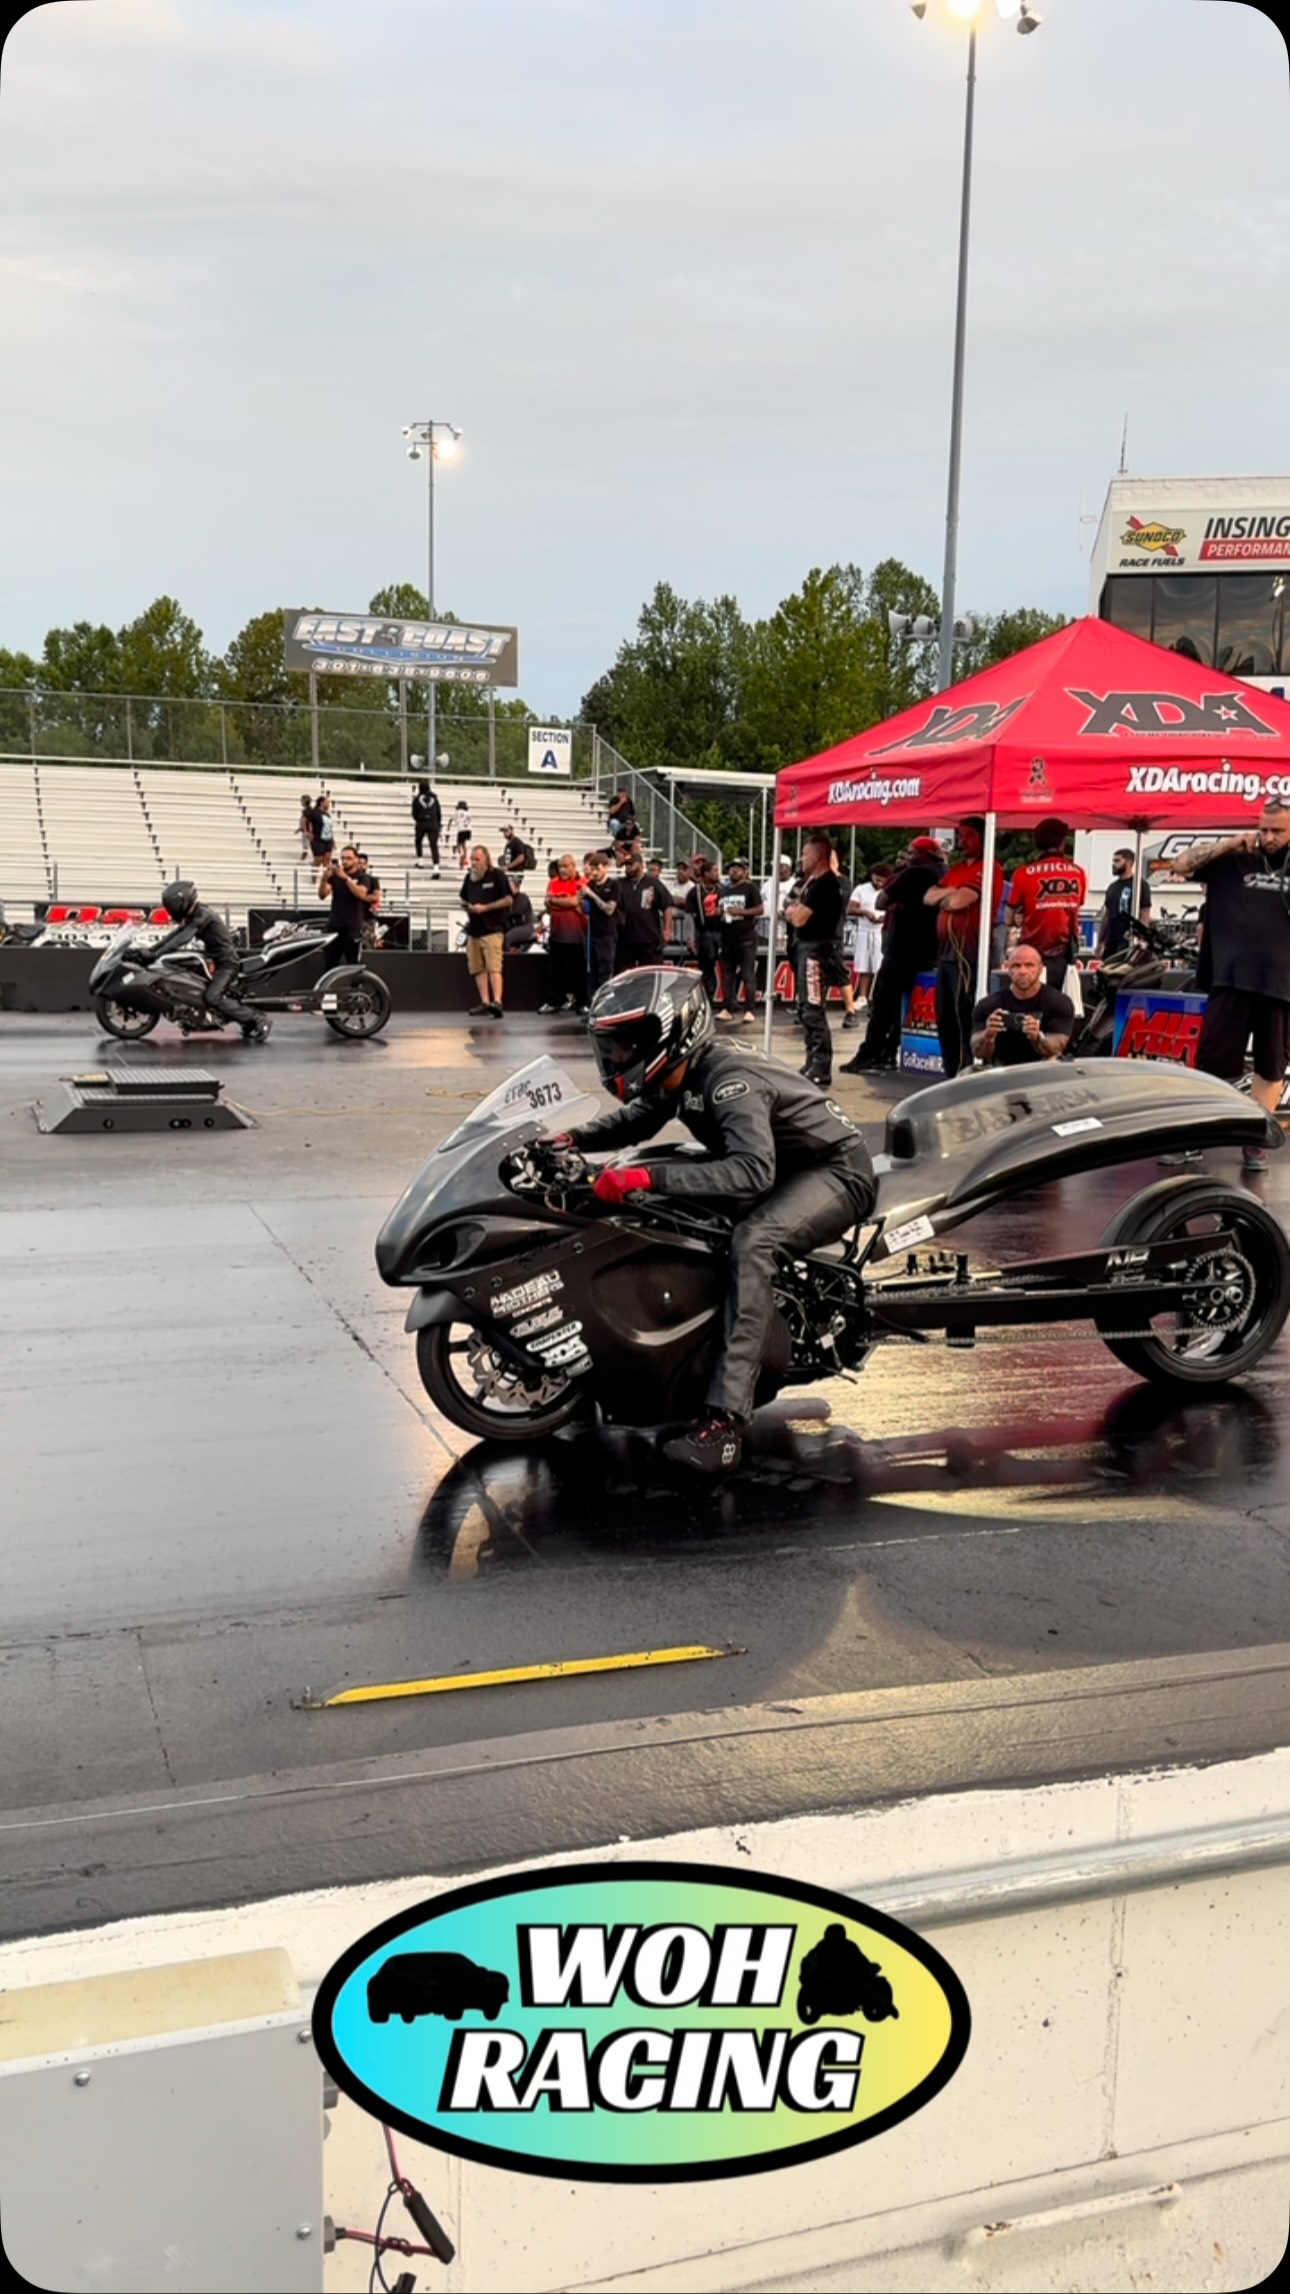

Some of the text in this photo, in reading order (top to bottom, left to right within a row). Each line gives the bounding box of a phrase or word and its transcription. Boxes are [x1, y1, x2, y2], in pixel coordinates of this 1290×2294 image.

[1124, 531, 1182, 543] SUNOCO
[1204, 516, 1290, 538] INSING
[1119, 557, 1186, 567] RACE FUELS
[293, 616, 512, 655] EAST COAST
[1063, 688, 1281, 737] XDA
[531, 730, 569, 744] SECTION
[540, 749, 558, 769] A
[526, 1082, 562, 1109] 3673
